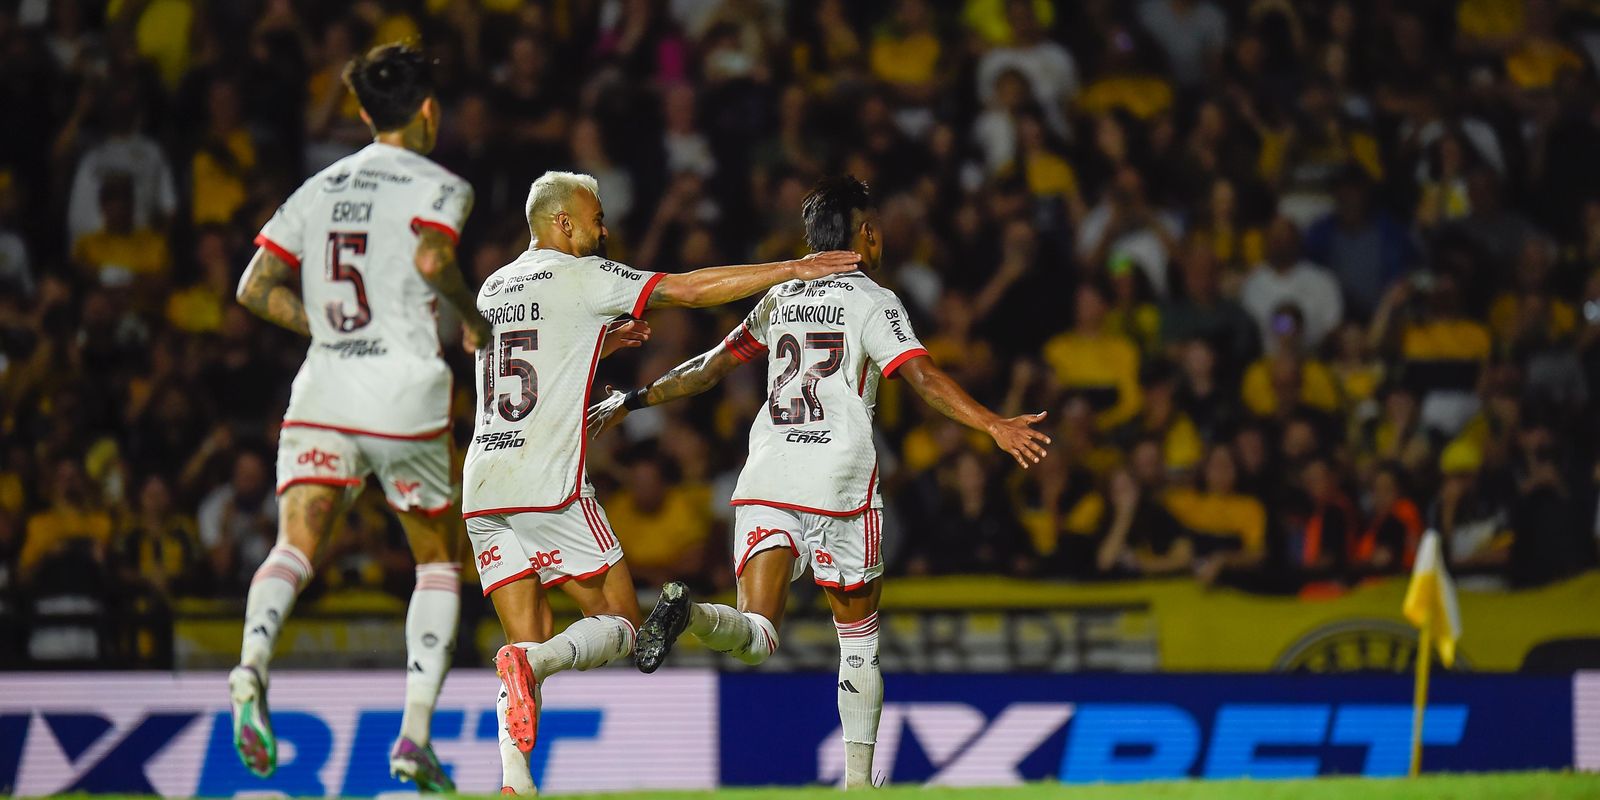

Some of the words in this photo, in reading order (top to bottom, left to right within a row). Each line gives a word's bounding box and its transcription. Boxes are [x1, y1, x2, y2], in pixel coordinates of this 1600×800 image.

[325, 231, 372, 334] 5
[506, 270, 553, 285] mercado
[613, 265, 643, 281] kwai
[808, 279, 855, 291] mercado
[531, 302, 544, 321] B.
[782, 304, 846, 326] HENRIQUE
[889, 319, 911, 344] kwai
[768, 331, 845, 426] 27
[484, 438, 526, 452] CARD
[785, 433, 832, 444] CARD
[529, 550, 563, 571] abc
